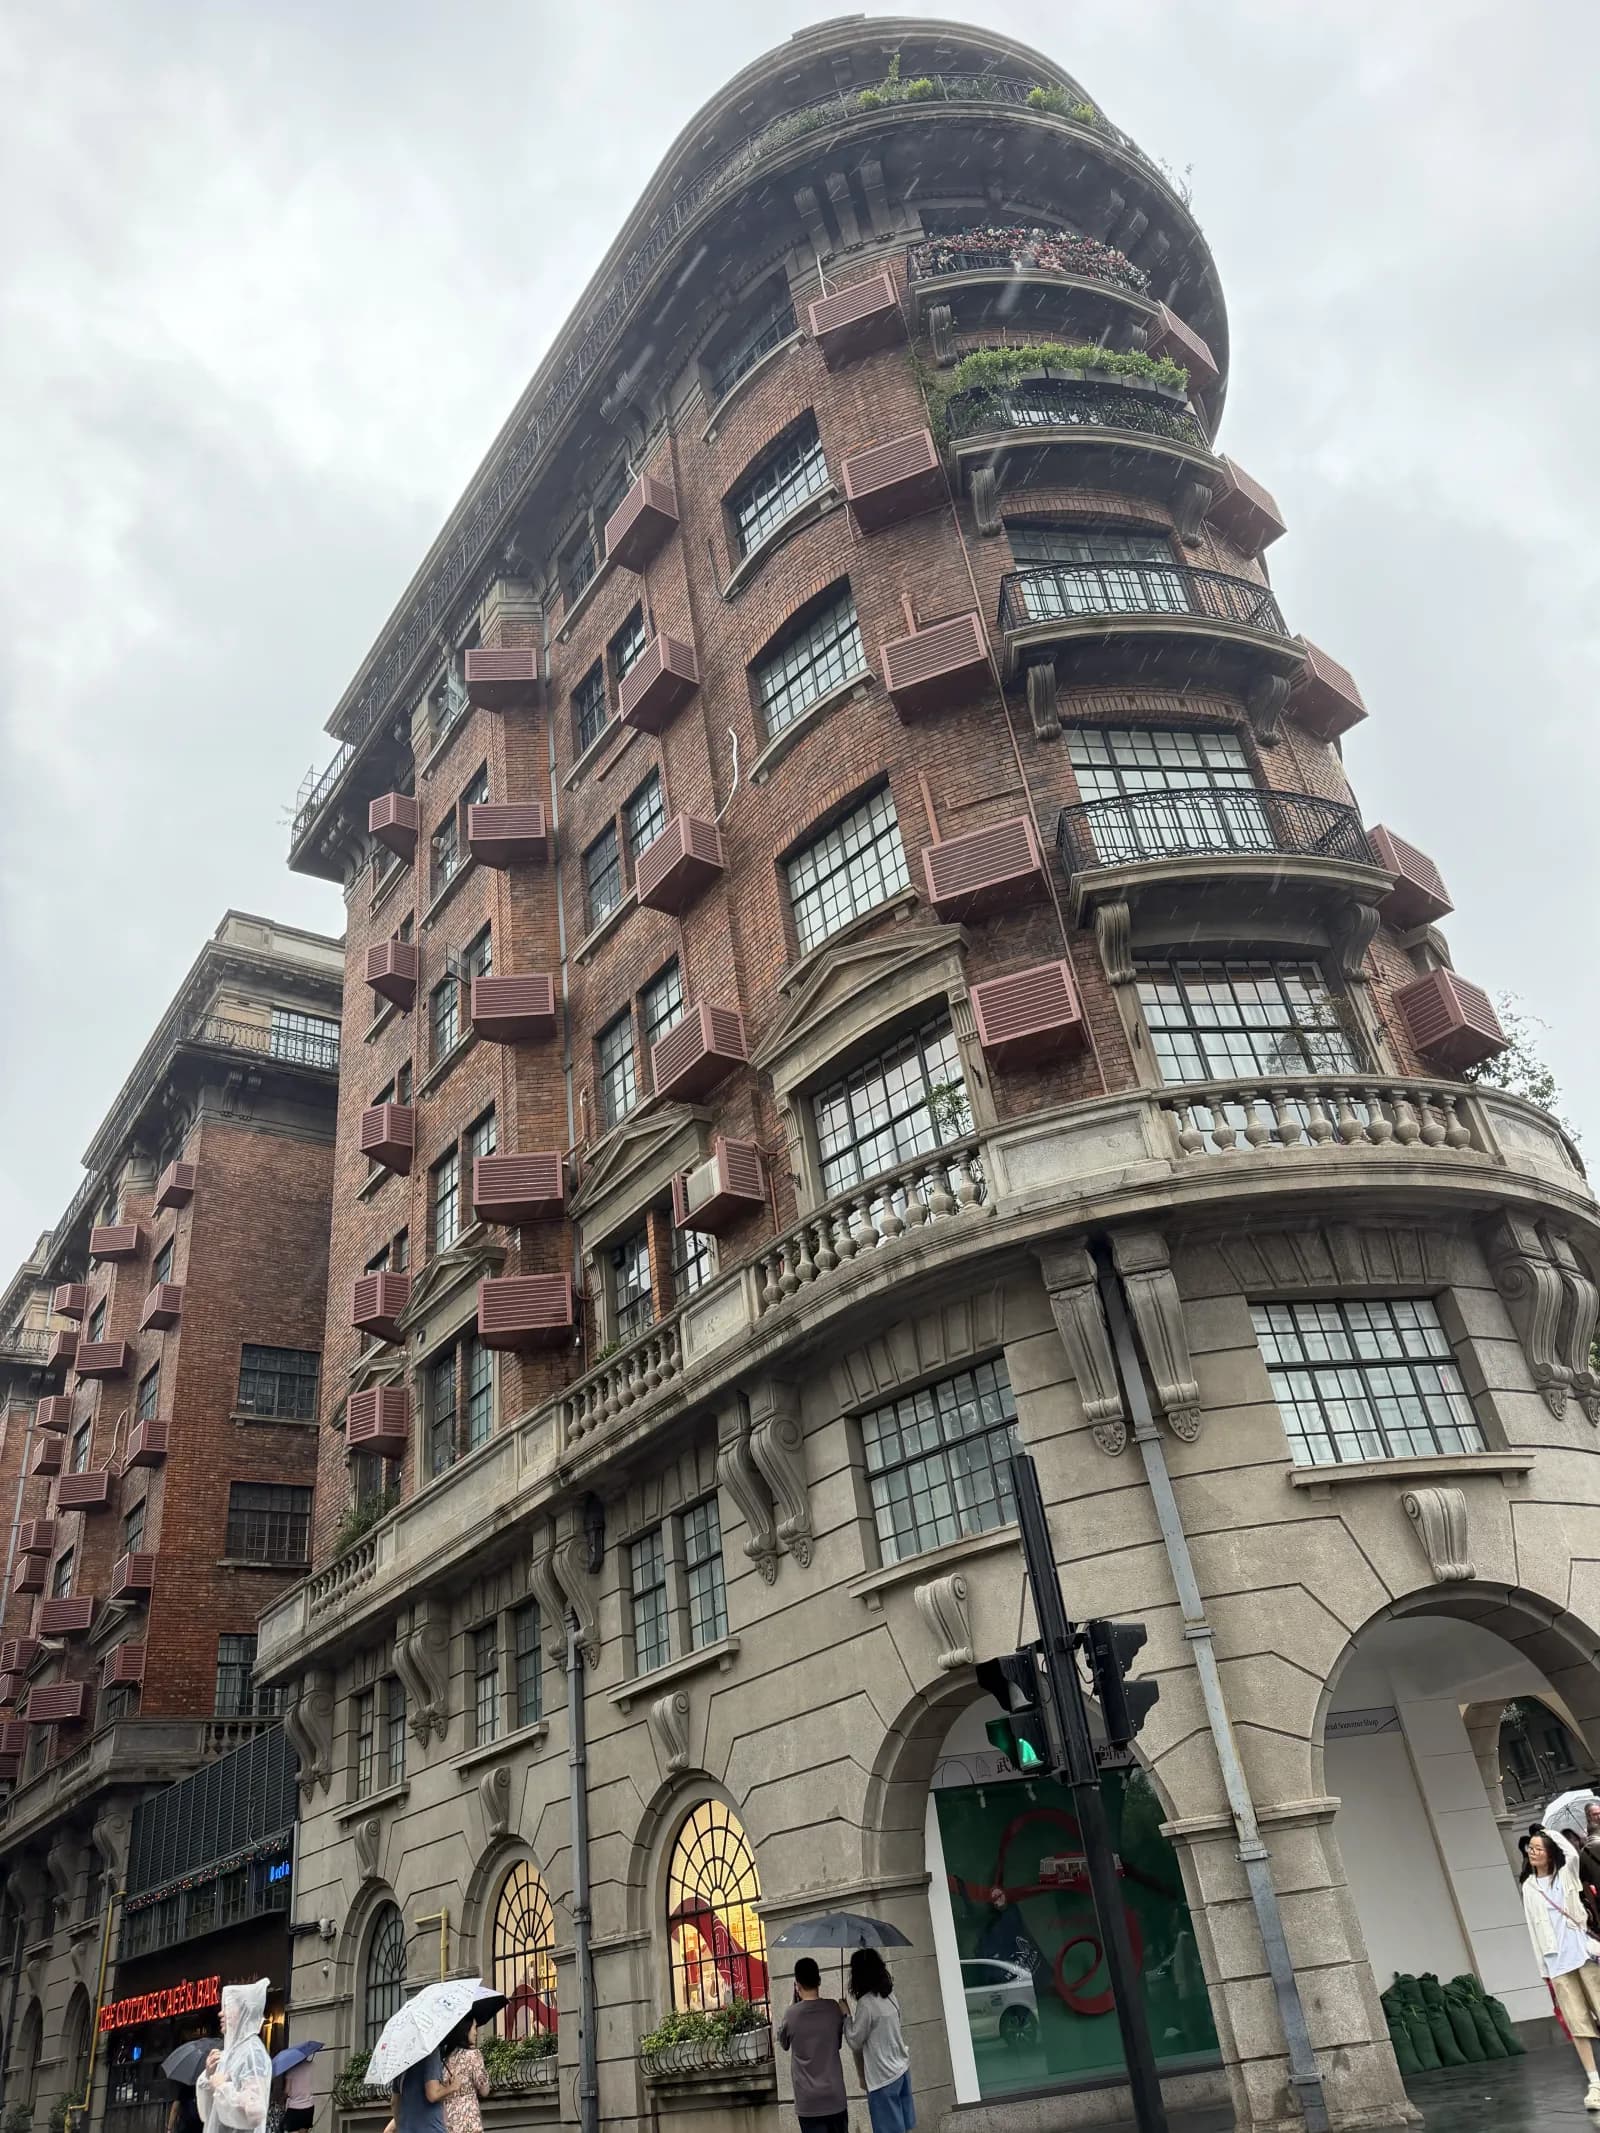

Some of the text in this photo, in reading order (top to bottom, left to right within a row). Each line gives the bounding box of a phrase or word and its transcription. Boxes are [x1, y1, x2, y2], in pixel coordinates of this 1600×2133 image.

[99, 2004, 116, 2031] THE
[117, 1992, 158, 2027] COTTAGE
[186, 1982, 195, 2010] &
[196, 1975, 221, 2008] BAR
